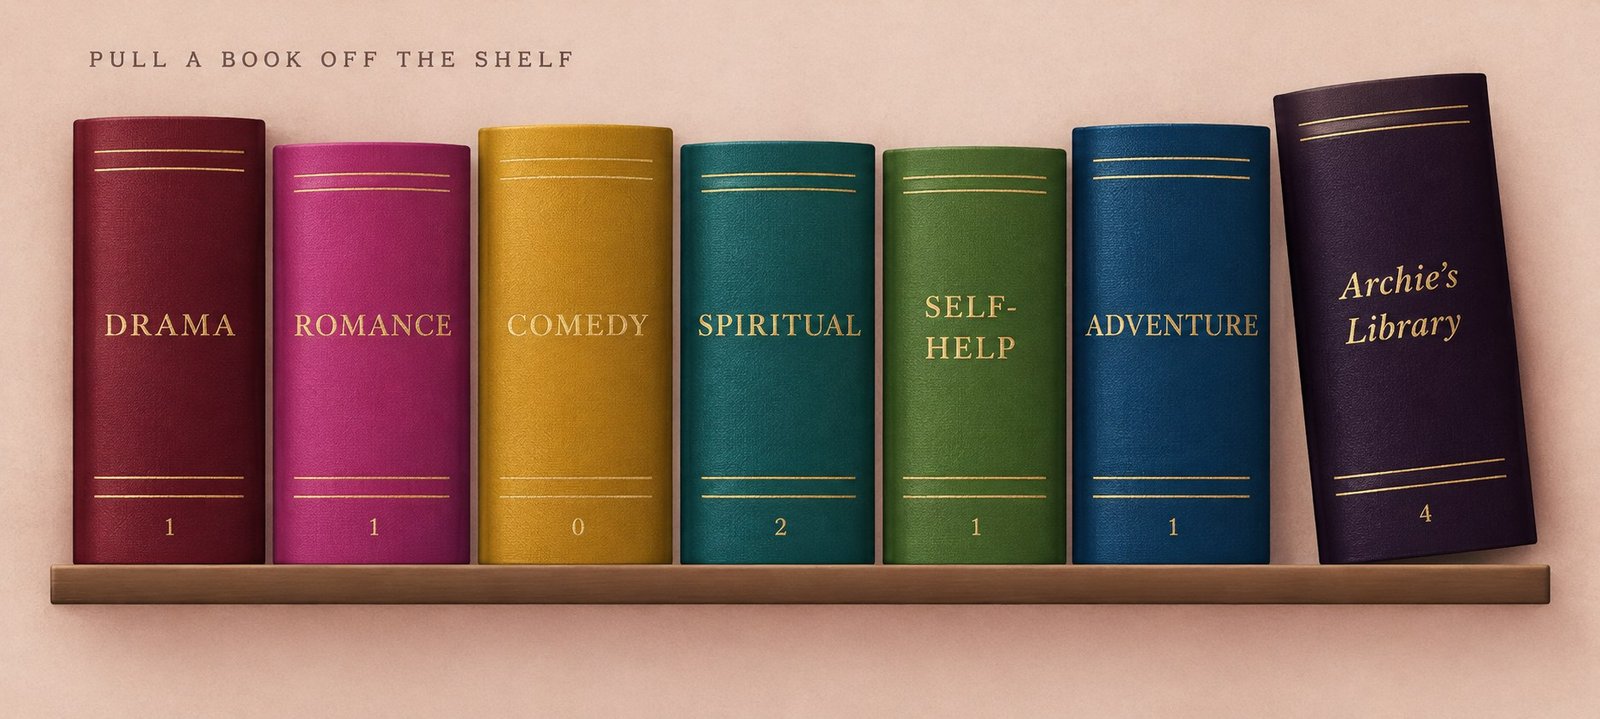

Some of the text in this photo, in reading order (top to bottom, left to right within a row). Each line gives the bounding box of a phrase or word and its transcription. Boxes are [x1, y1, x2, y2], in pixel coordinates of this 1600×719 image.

[90, 51, 572, 67] PULL A BOOK OFF THE SHELF
[926, 296, 1016, 318] SELF-
[105, 314, 235, 336] DRAMA
[295, 314, 451, 336] ROMANCE
[508, 314, 648, 336] COMEDY
[699, 314, 861, 336] SPIRITUAL
[1086, 314, 1258, 336] ADVENTURE
[1346, 313, 1460, 344] Library
[926, 337, 1015, 359] HELP
[1420, 504, 1431, 522] 4
[166, 518, 174, 535] 1
[370, 518, 378, 535] 1
[572, 518, 584, 535] 0
[775, 518, 786, 535] 2
[972, 518, 980, 535] 1
[1170, 518, 1178, 535] 1
